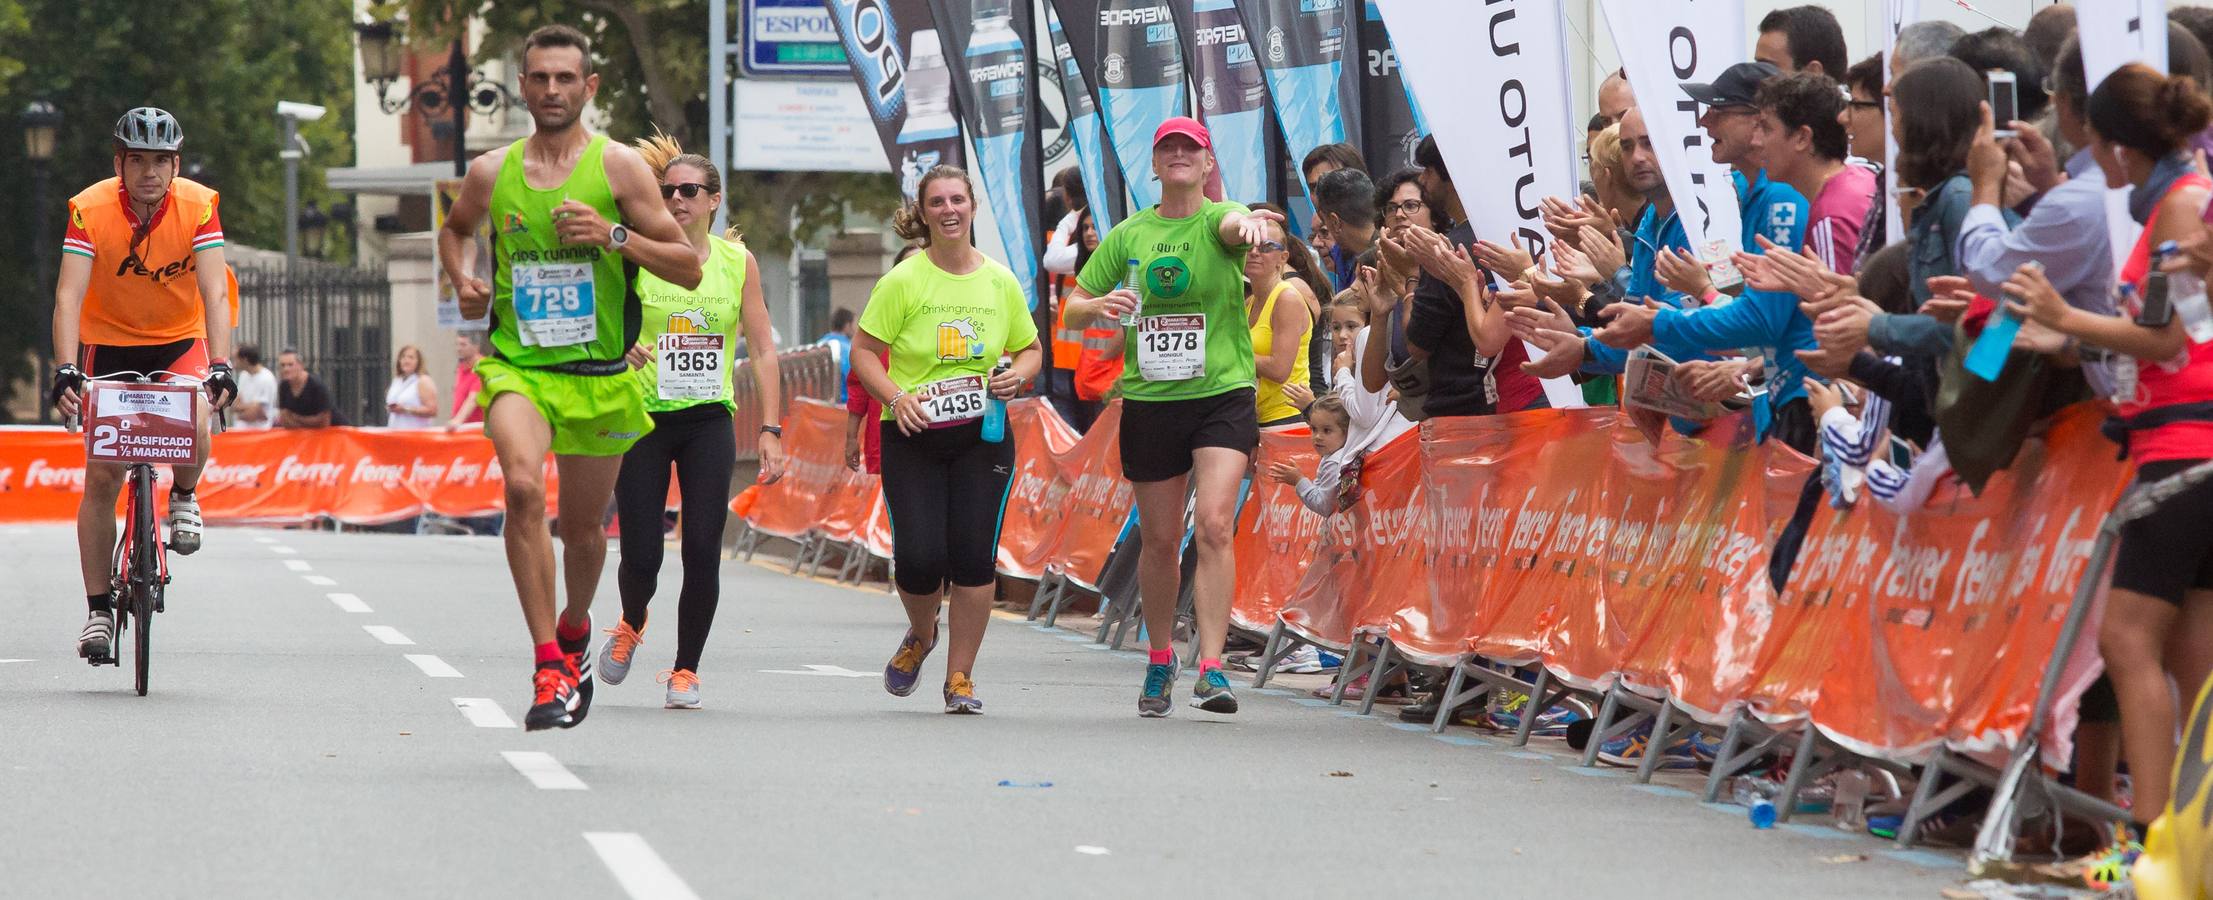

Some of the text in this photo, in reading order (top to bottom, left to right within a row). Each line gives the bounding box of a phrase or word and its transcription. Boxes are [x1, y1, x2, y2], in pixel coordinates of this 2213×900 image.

[526, 286, 580, 313] 728
[1145, 332, 1197, 353] 1378
[665, 351, 718, 371] 1363
[928, 392, 983, 417] 1436
[120, 434, 193, 447] CLASIFICADO
[133, 446, 191, 459] MARATÓN
